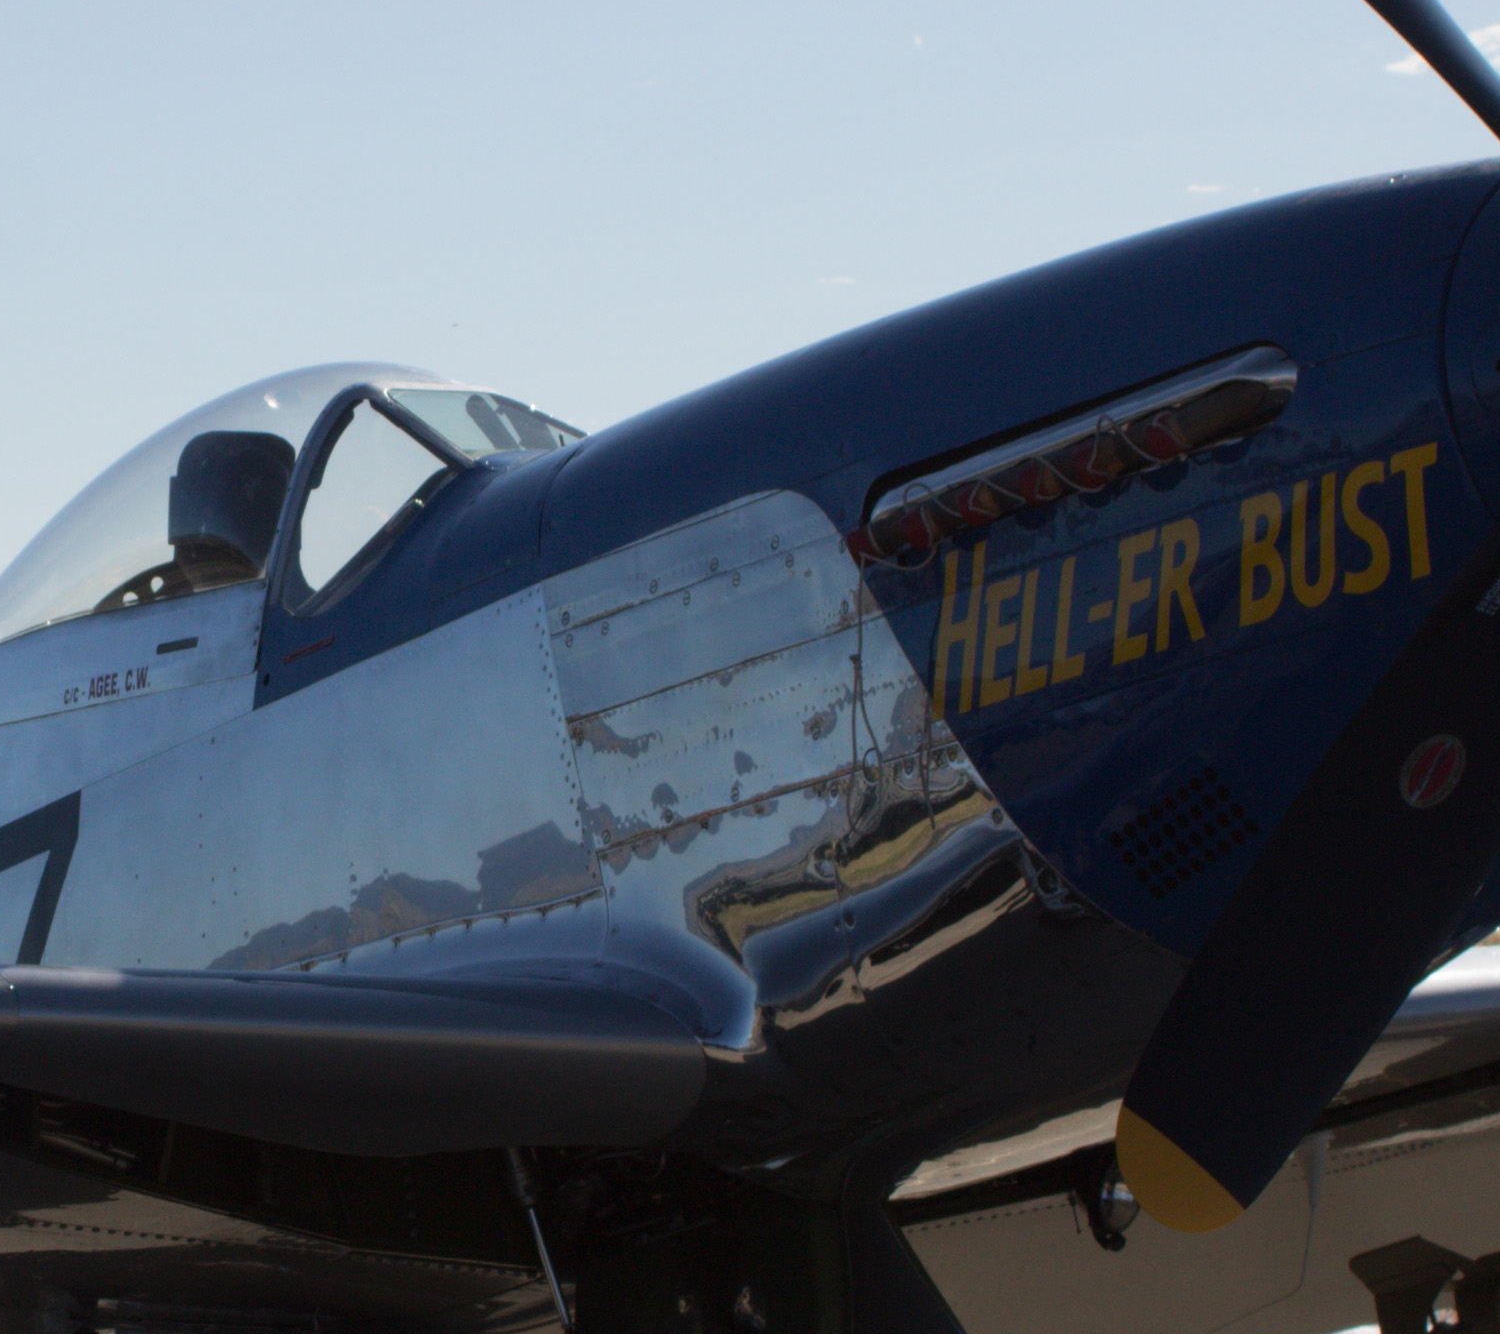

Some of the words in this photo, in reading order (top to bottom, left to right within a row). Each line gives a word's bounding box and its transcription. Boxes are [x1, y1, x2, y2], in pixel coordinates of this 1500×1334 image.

[932, 518, 1205, 721] HELL-ER
[1240, 442, 1439, 627] BUST
[88, 673, 120, 700] AGEE,
[125, 666, 151, 692] C.W.
